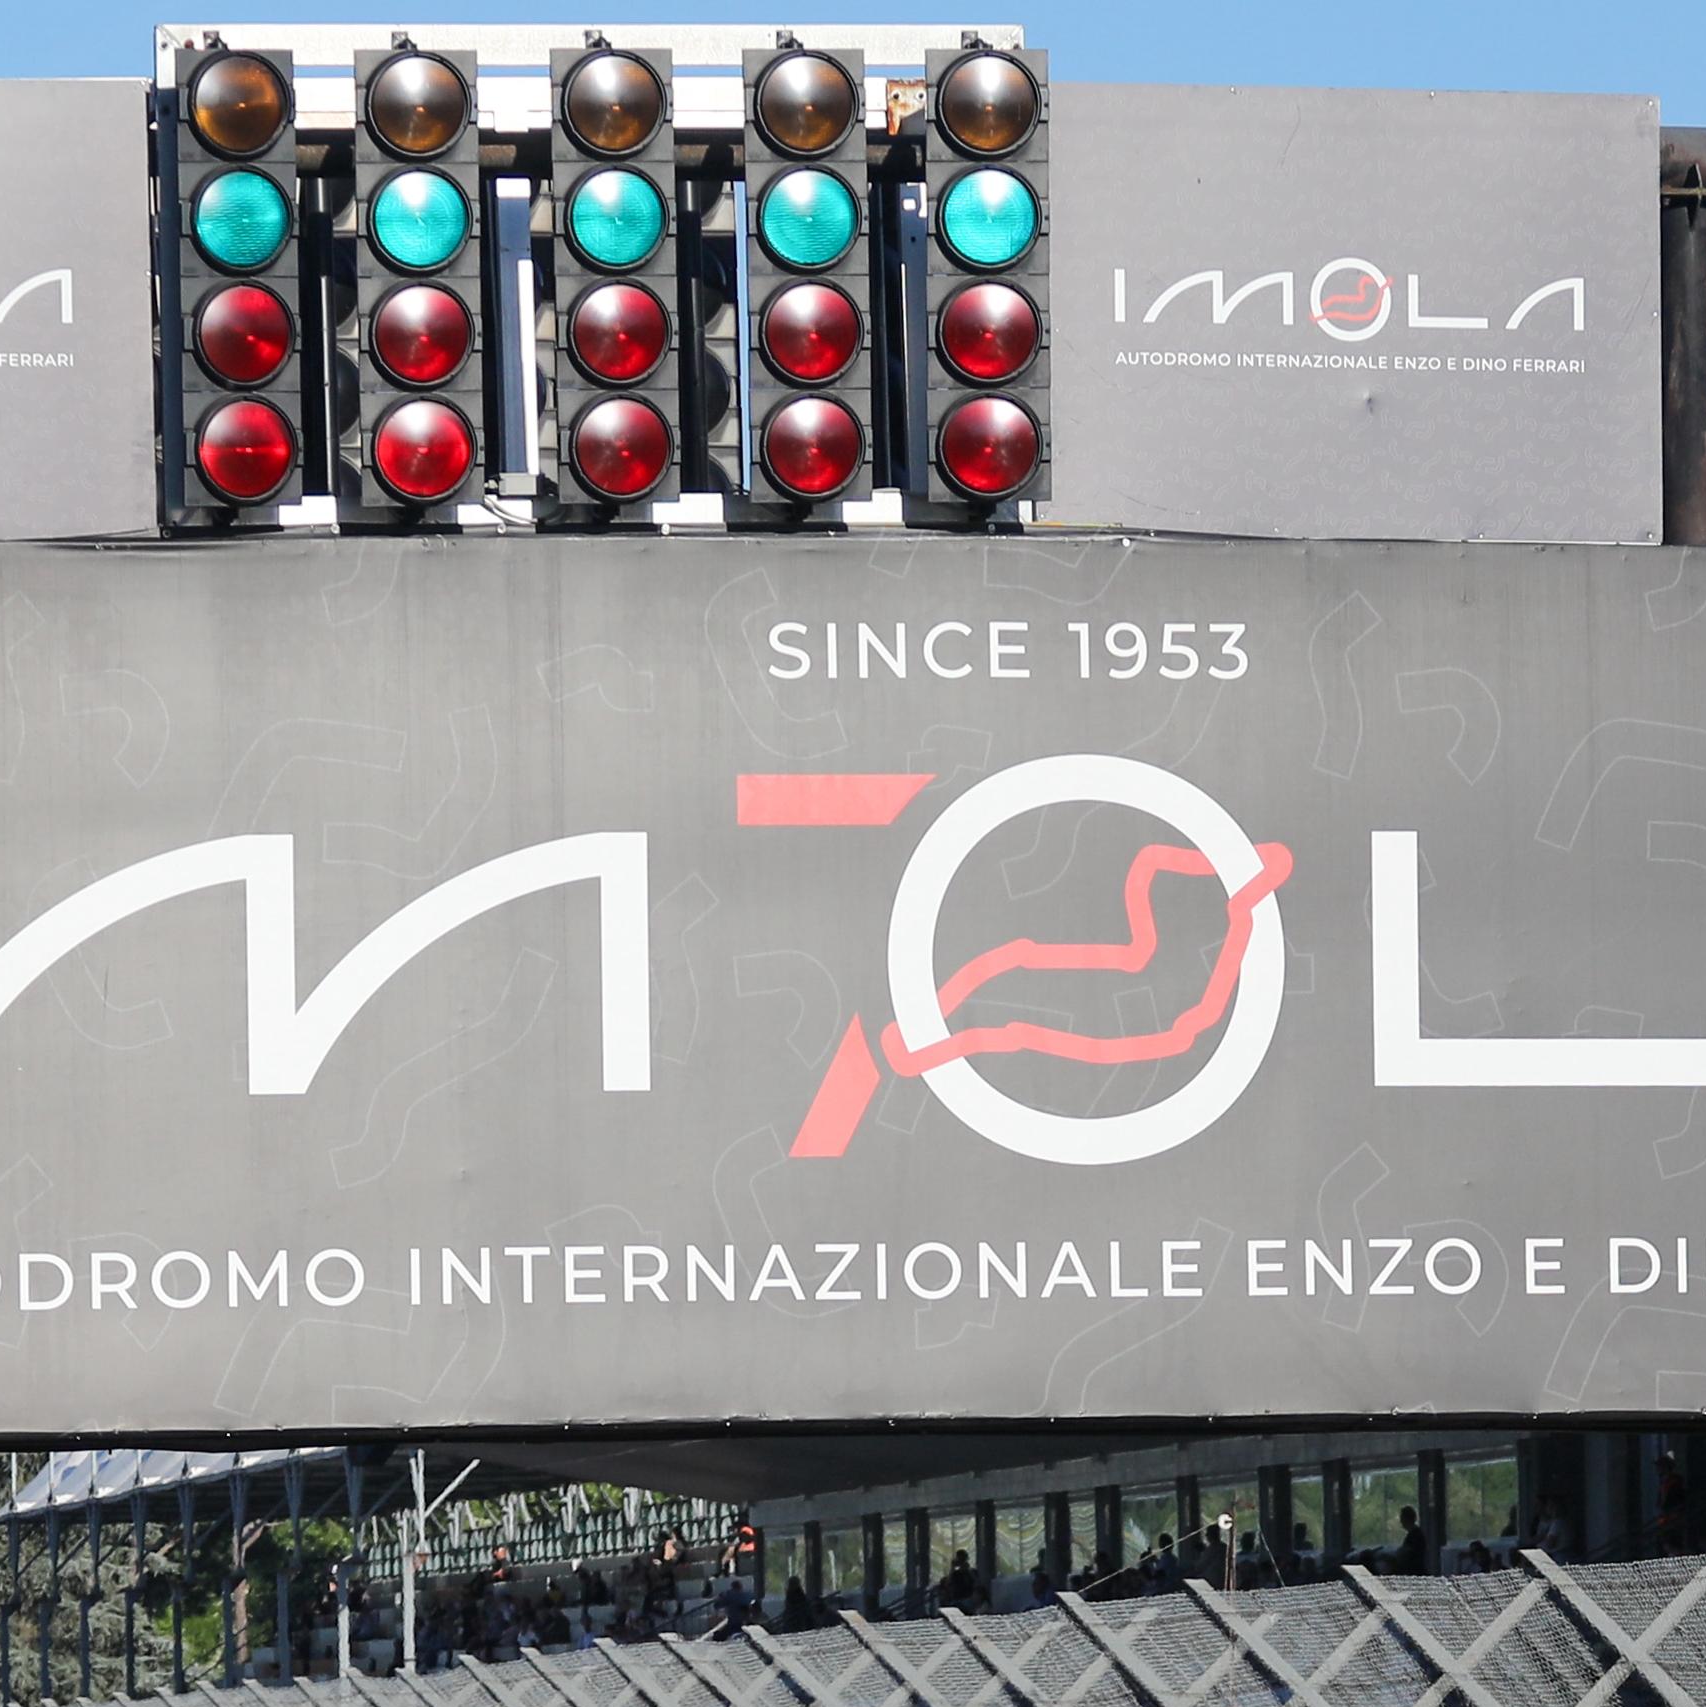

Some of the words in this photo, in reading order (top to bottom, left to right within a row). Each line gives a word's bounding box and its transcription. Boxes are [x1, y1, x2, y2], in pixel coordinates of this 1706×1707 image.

[1113, 258, 1585, 343] IMOLA
[1115, 352, 1232, 368] AUTODROMO
[1237, 354, 1389, 371] INTERNAZIONALE
[1395, 356, 1443, 372] ENZO
[1448, 358, 1458, 372] E
[1463, 358, 1508, 373] DINO
[1513, 359, 1586, 374] FERRARI
[767, 622, 1031, 682] SINCE
[1067, 622, 1251, 682] 1953
[410, 1239, 1205, 1308] INTERNAZIONALE
[1247, 1236, 1483, 1299] ENZO
[1525, 1237, 1568, 1296] E
